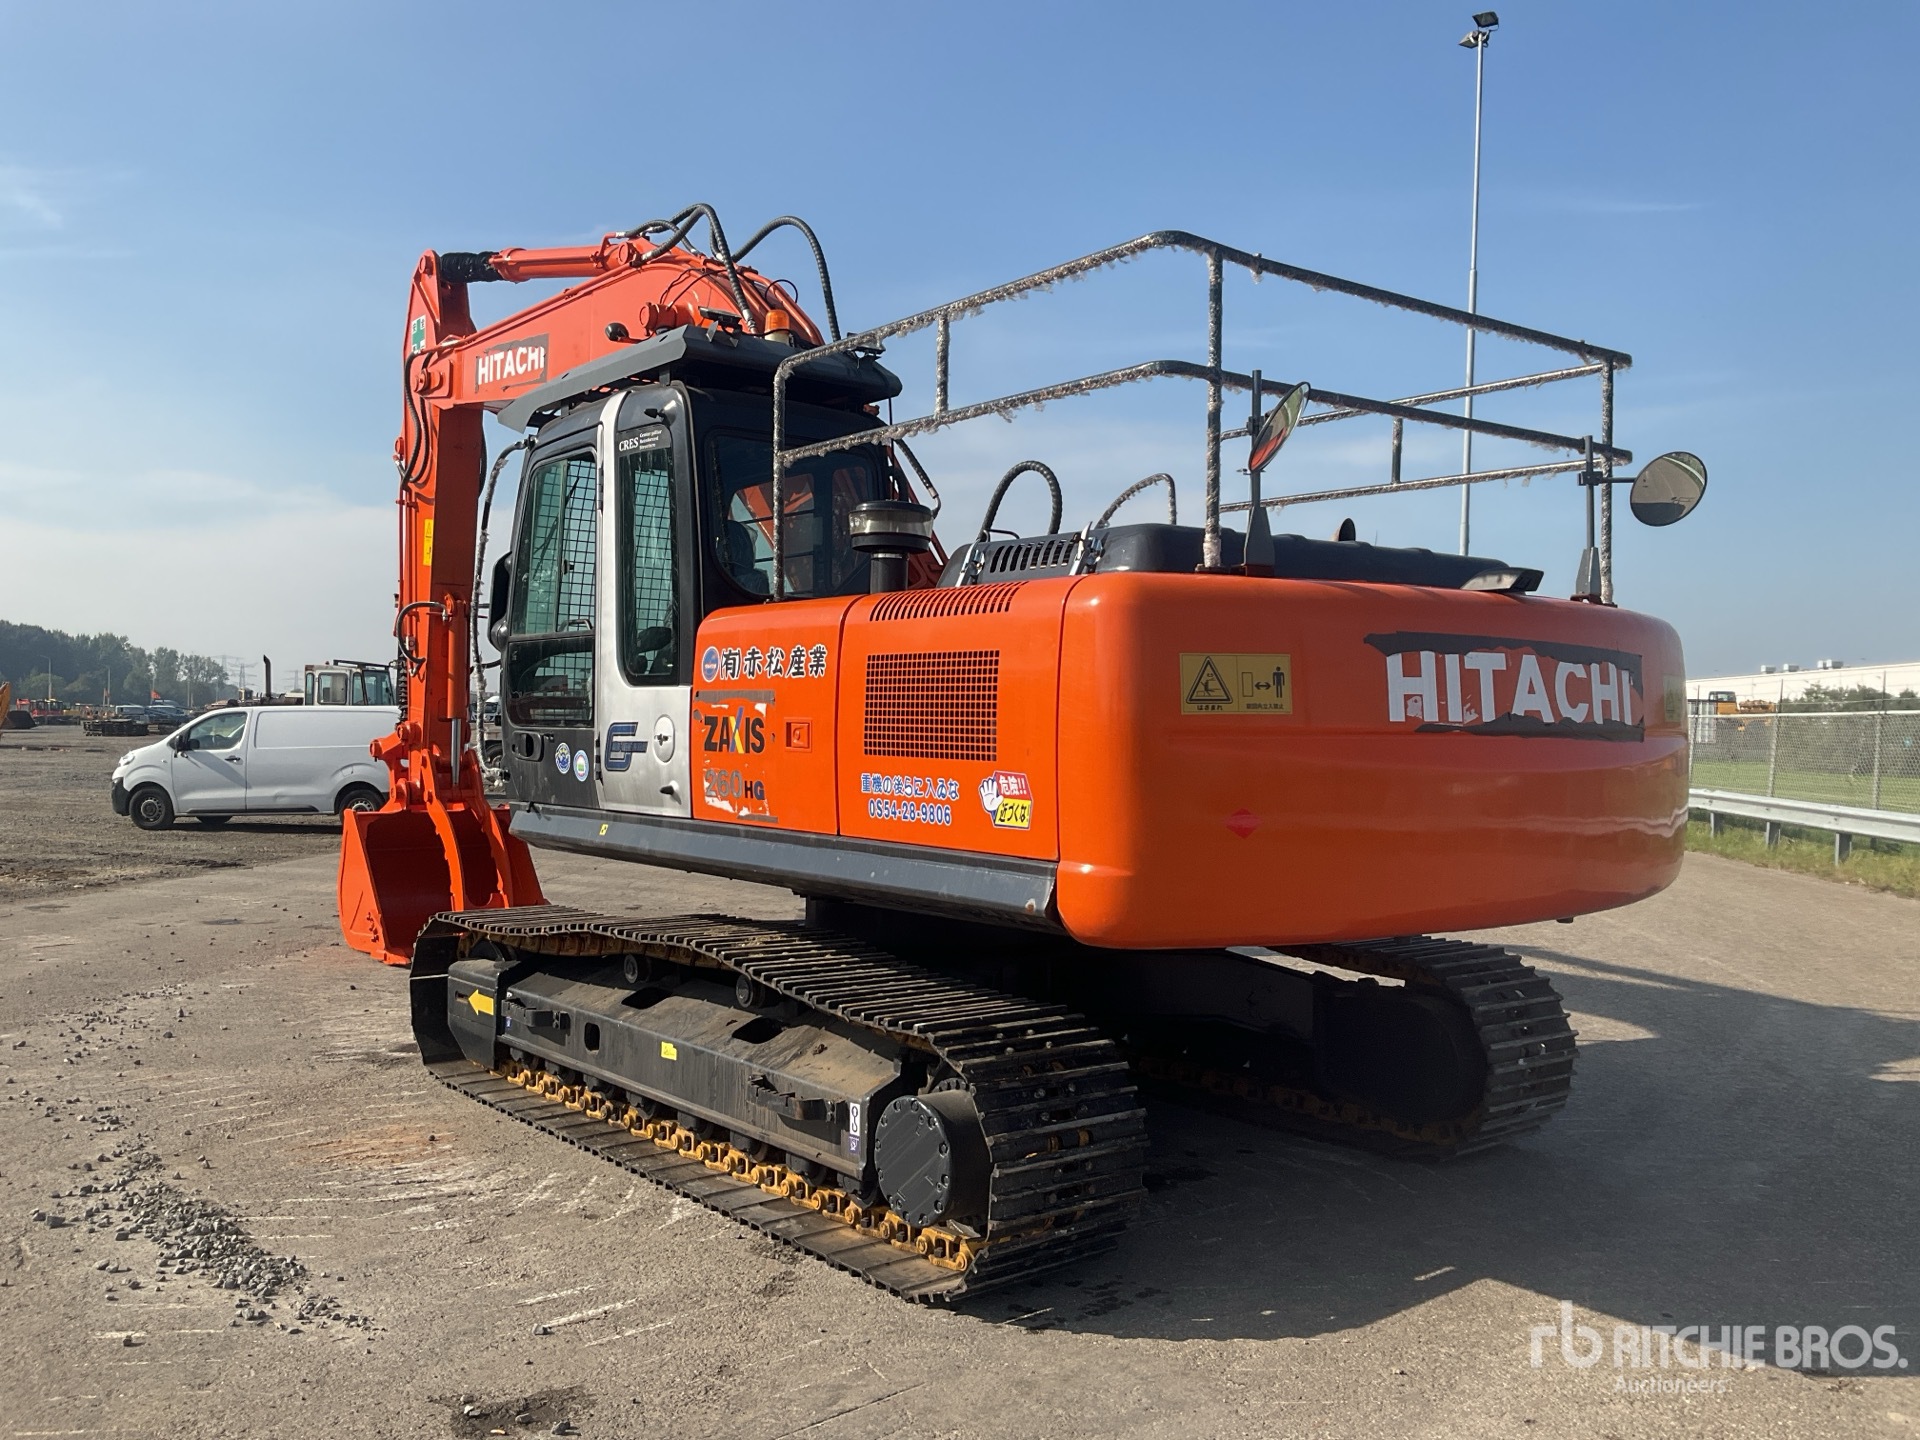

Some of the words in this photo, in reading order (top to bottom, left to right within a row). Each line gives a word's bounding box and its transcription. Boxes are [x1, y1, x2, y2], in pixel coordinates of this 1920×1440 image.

[477, 346, 545, 385] HITACHI
[619, 437, 639, 451] CRES
[1386, 650, 1634, 725] HITACHI
[704, 706, 765, 754] ZAXIS
